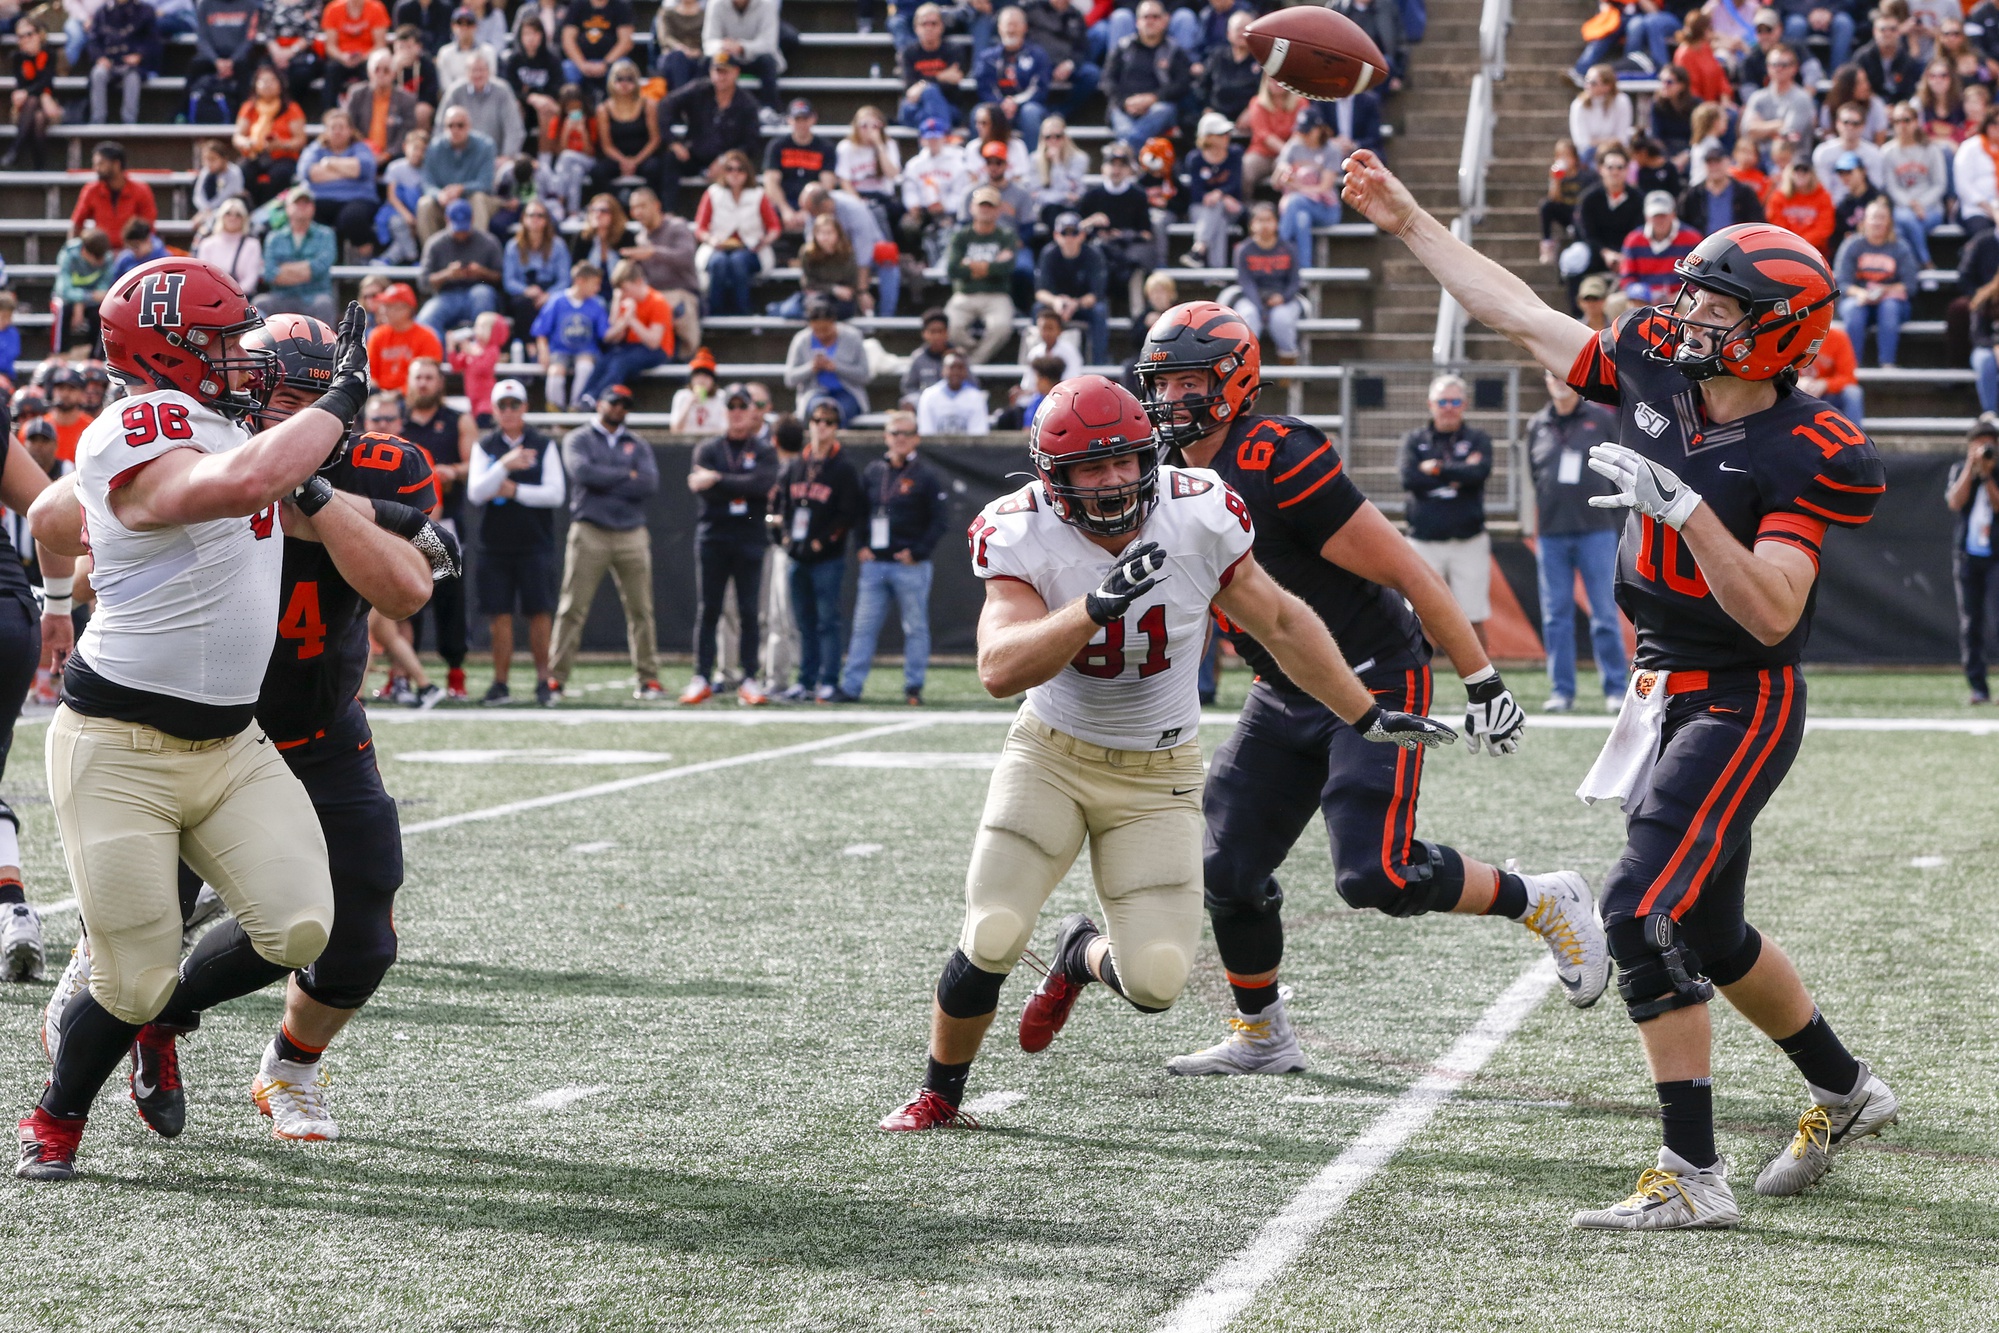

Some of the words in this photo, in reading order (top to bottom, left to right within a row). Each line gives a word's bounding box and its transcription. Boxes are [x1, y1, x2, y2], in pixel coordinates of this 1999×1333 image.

[138, 273, 187, 328] H
[308, 367, 331, 380] 1869
[121, 401, 194, 448] 96
[1236, 419, 1292, 471] 67
[1691, 433, 1704, 446] P
[1791, 410, 1866, 460] 10
[1635, 511, 1710, 599] 10
[1069, 603, 1172, 680] 81
